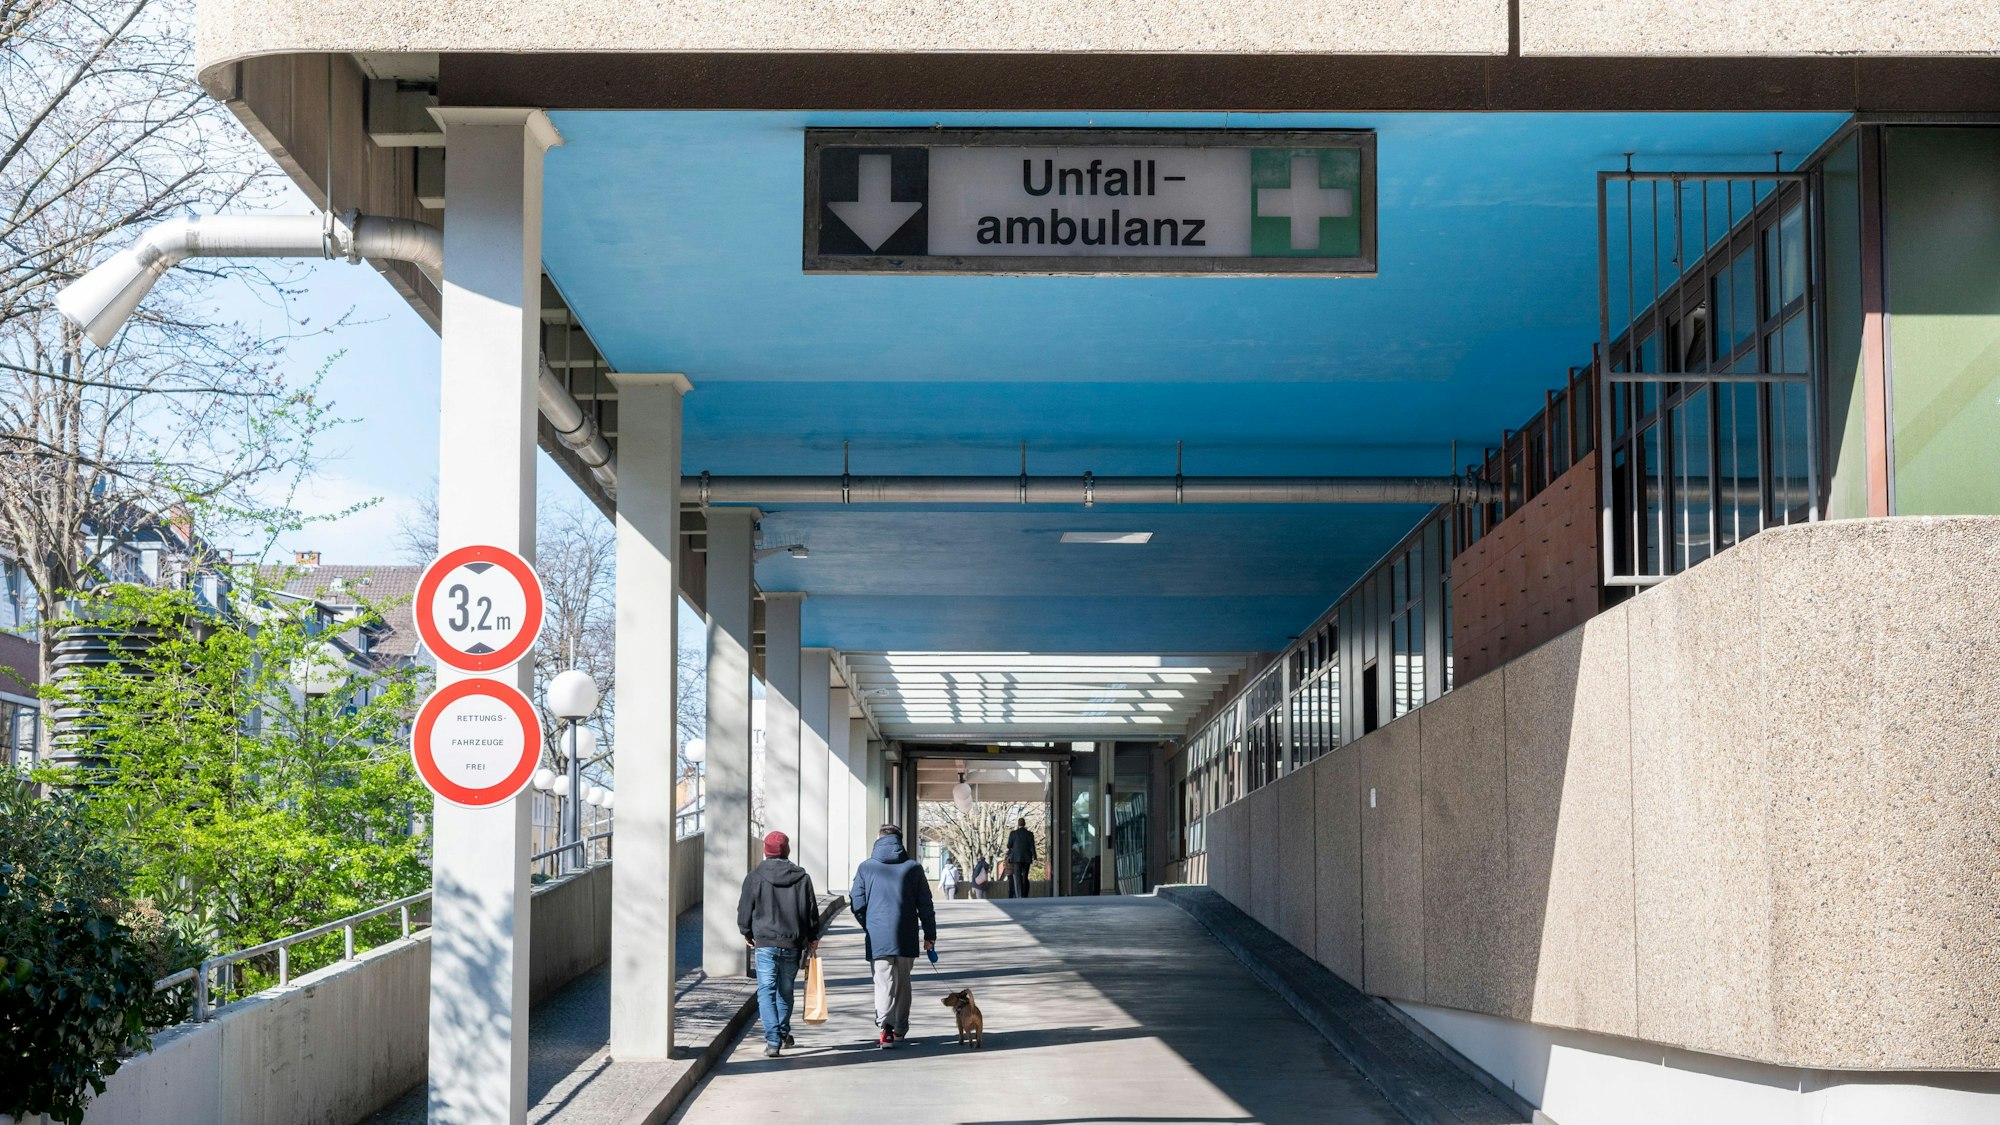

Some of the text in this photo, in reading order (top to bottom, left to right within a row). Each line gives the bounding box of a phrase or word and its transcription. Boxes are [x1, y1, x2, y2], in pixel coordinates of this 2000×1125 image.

[1022, 158, 1186, 197] Unfall-
[976, 208, 1206, 247] ambulanz
[448, 583, 492, 633] 3,2
[456, 714, 507, 722] RETTUNGS-
[451, 738, 504, 746] FAHRZEUGE
[465, 763, 486, 771] FREI
